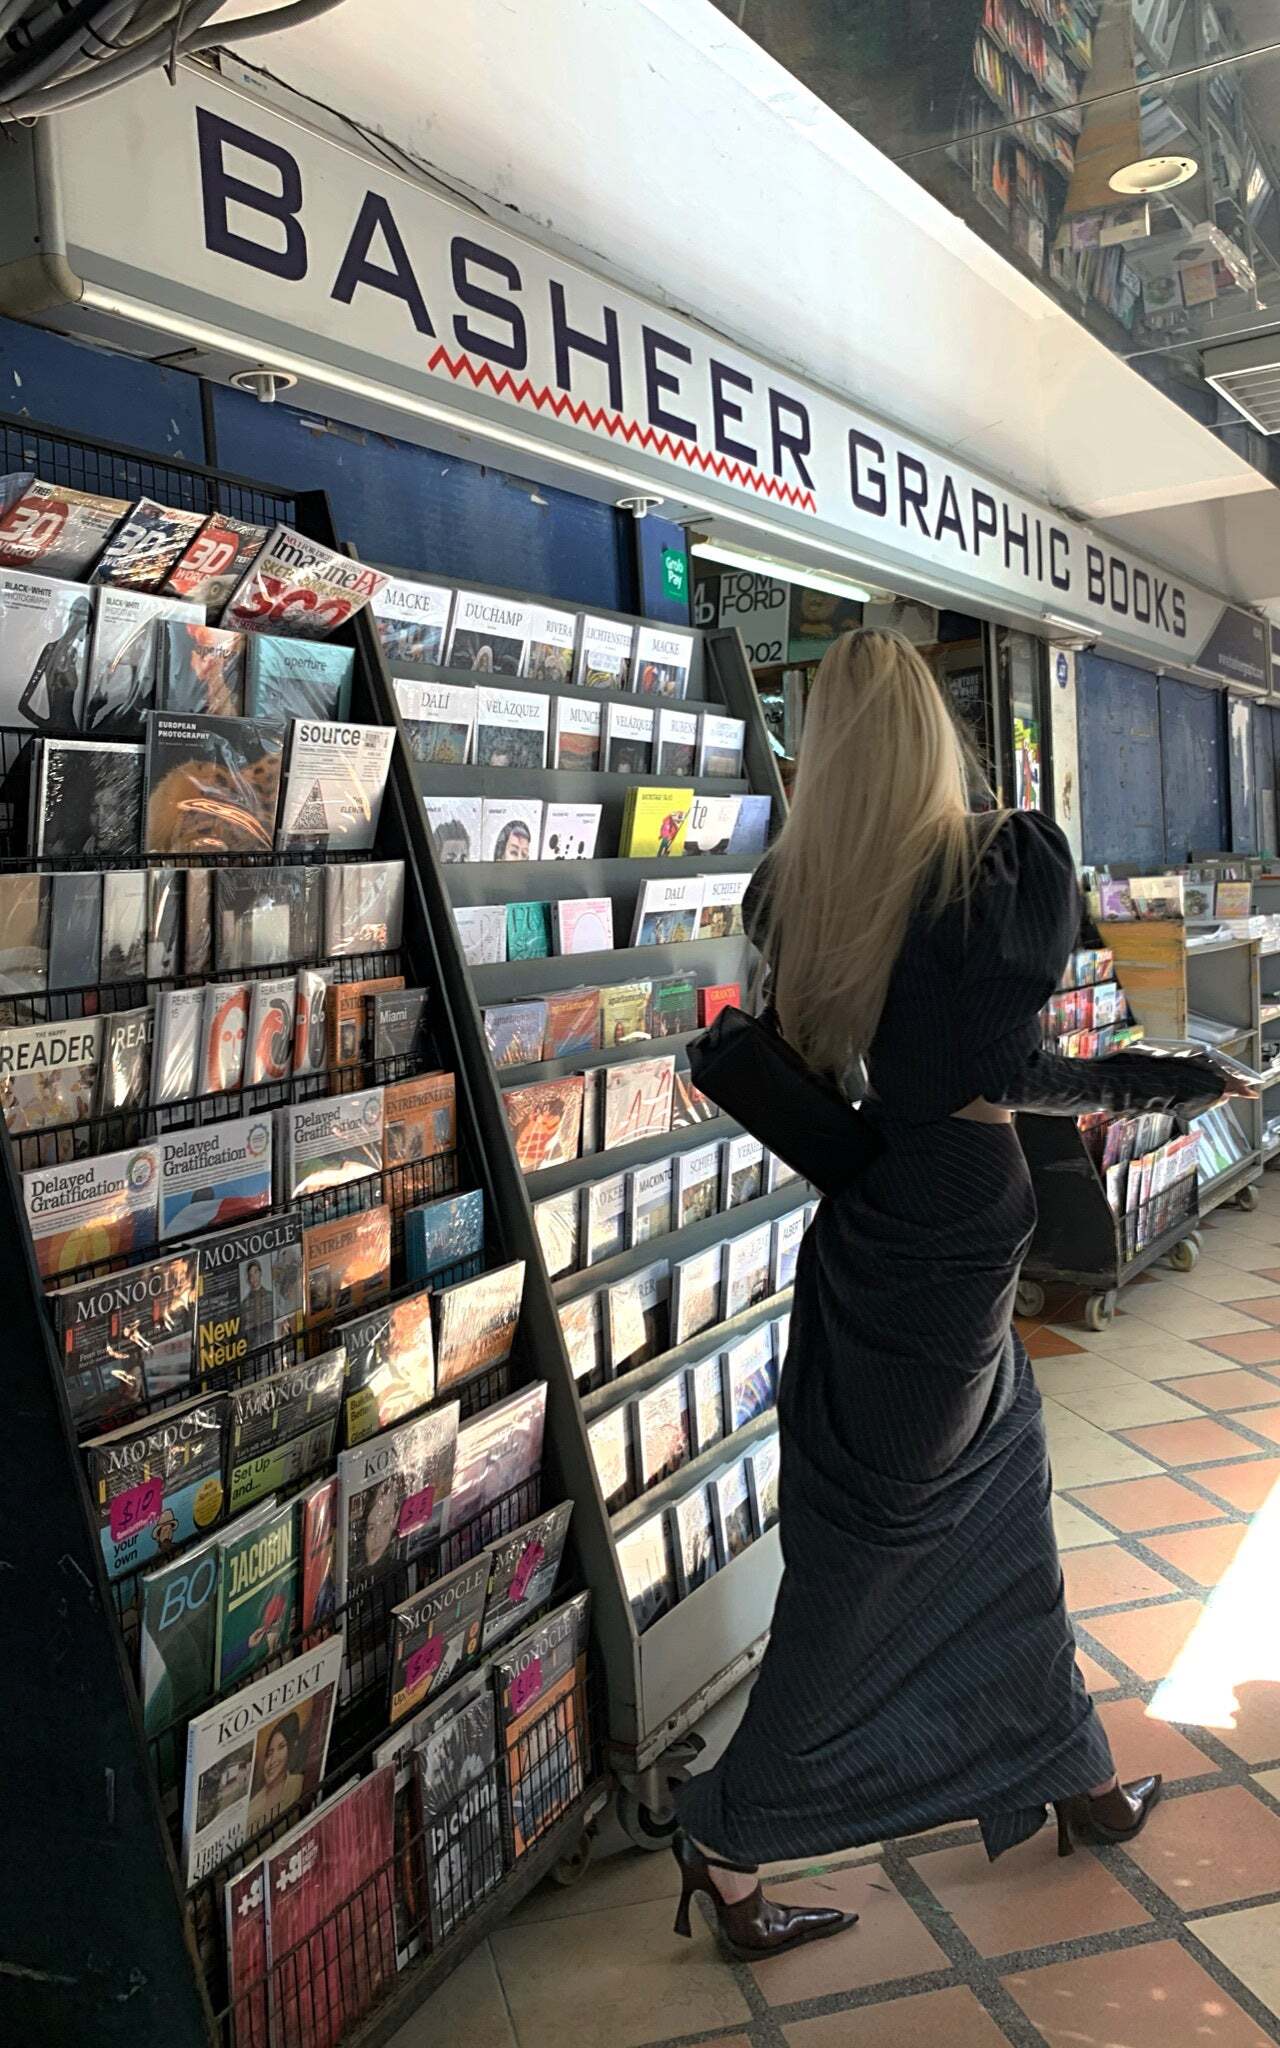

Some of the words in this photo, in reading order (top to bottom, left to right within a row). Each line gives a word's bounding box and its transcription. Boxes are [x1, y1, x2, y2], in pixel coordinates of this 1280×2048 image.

[195, 105, 816, 491] BASHEER
[848, 428, 1071, 592] GRAPHIC
[1086, 543, 1187, 639] BOOKS
[178, 537, 238, 576] 3D
[722, 573, 773, 596] TOM
[384, 588, 431, 612] MACKE
[721, 588, 786, 616] FORD
[464, 602, 523, 627] DUCHAMP
[651, 638, 680, 655] MACKE
[283, 655, 327, 672] aperture
[420, 688, 451, 710] DALÍ
[485, 697, 541, 720] VELÁZQUEZ
[158, 720, 197, 731] EUROPEAN
[158, 730, 210, 740] PHOTOGRAPHY
[299, 723, 361, 746] source
[380, 1007, 408, 1025] Miami
[0, 1033, 95, 1073] READER
[294, 1106, 341, 1131] Delayed
[163, 1135, 220, 1162] Delayed
[163, 1147, 247, 1177] Gratification
[30, 1178, 126, 1213] Gratification
[31, 1167, 95, 1198] Delayed
[204, 1227, 296, 1271] MONOCLE
[75, 1270, 187, 1323] MONOCLE
[200, 1316, 241, 1348] New
[200, 1338, 248, 1373] Neue
[233, 1463, 253, 1484] Set
[255, 1456, 271, 1475] Up
[113, 1534, 139, 1558] your
[114, 1549, 138, 1569] own
[228, 1519, 292, 1599] JACOBIN
[406, 1568, 483, 1631] MONOCLE
[217, 1660, 325, 1744] KONFEKT
